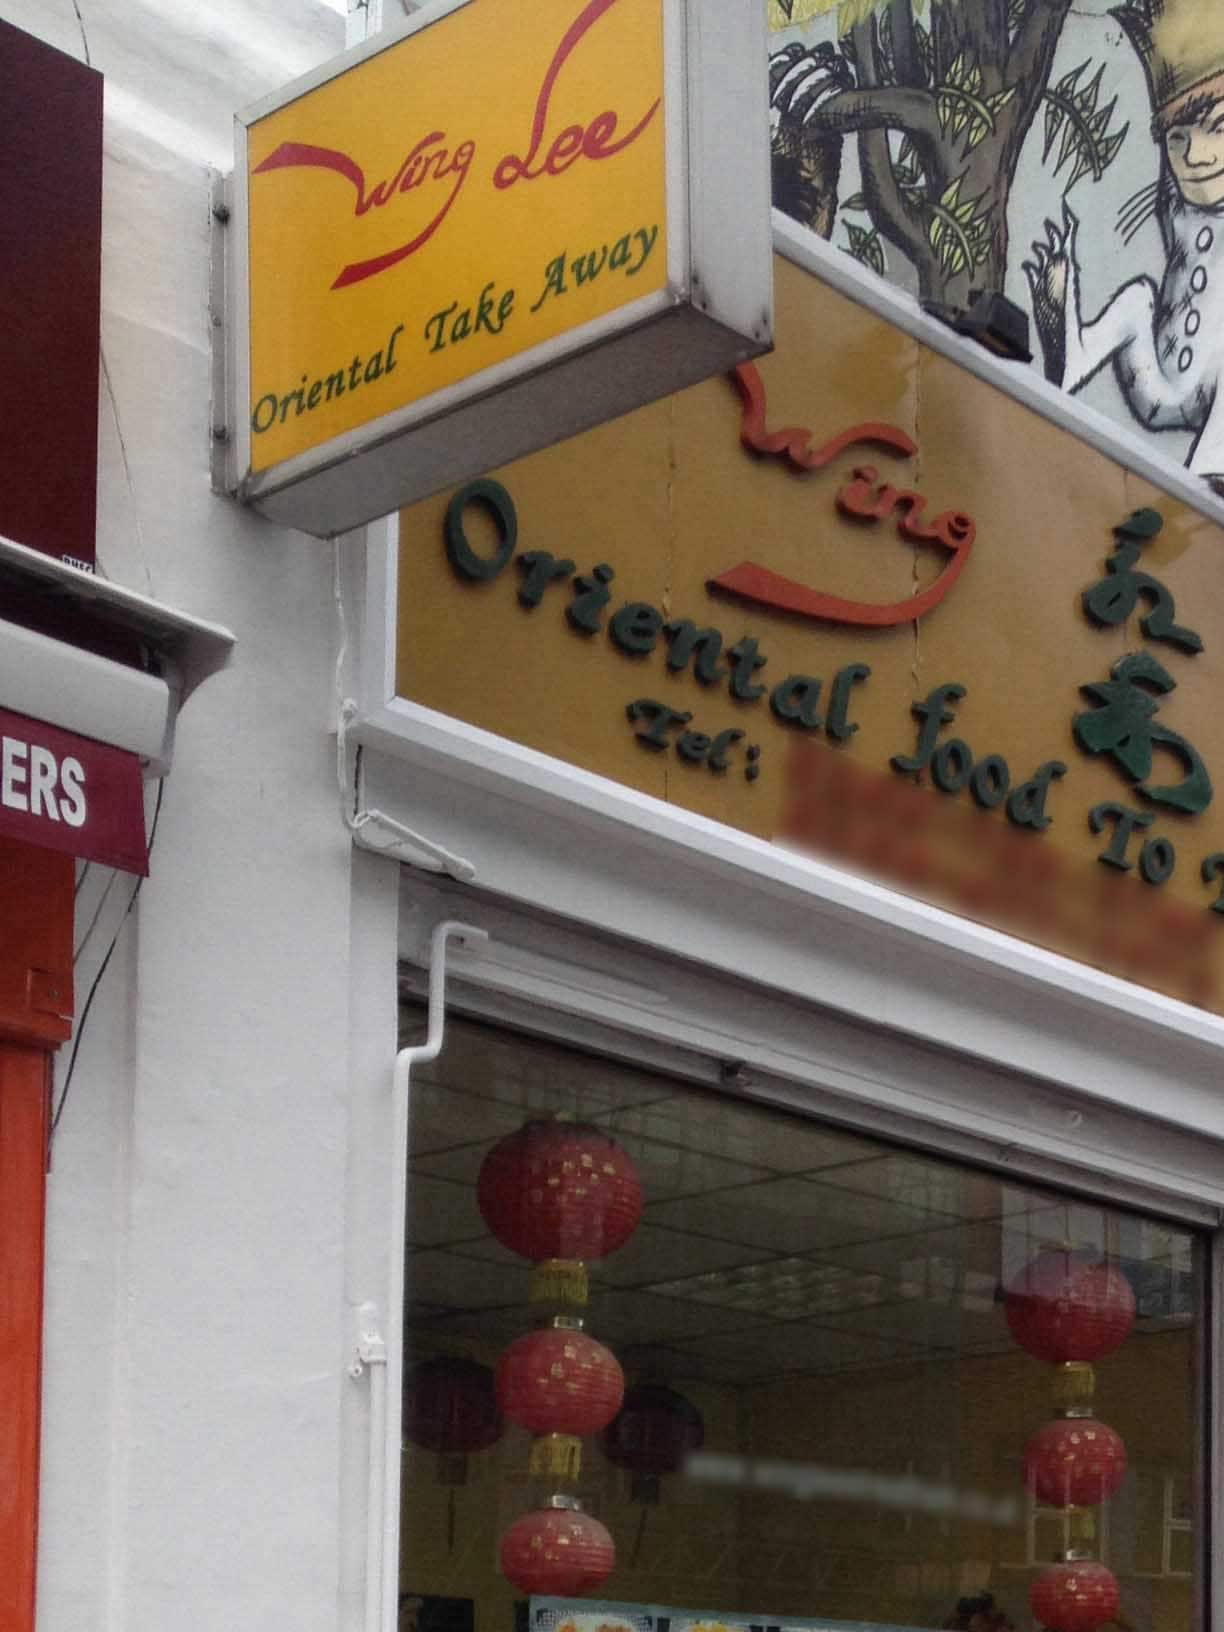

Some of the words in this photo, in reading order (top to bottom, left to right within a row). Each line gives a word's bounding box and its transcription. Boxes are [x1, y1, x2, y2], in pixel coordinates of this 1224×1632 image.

[251, 131, 477, 291] Wing
[492, 0, 661, 190] Lee
[251, 325, 404, 434] Oriental
[424, 281, 516, 354] Take
[530, 224, 660, 313] Away
[706, 362, 977, 627] Wing
[444, 477, 871, 742] Oriental
[890, 683, 1067, 831] food
[1089, 803, 1175, 886] To
[626, 699, 761, 782] Tel:
